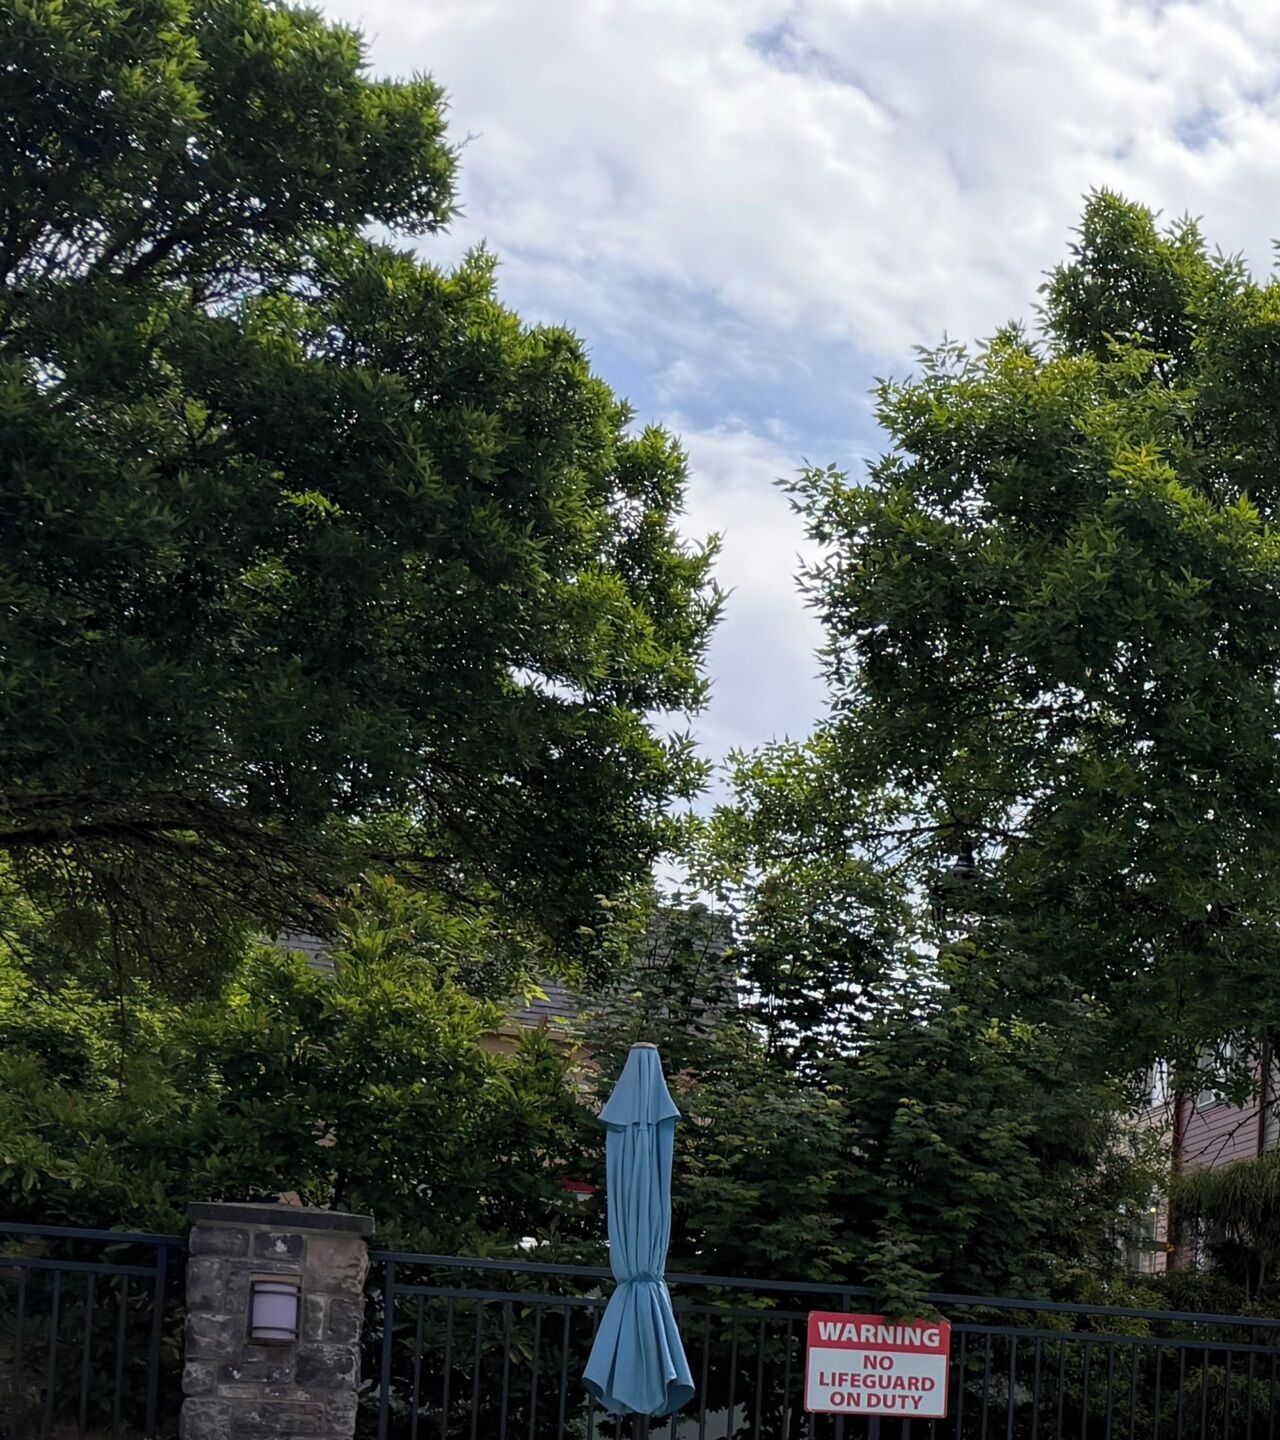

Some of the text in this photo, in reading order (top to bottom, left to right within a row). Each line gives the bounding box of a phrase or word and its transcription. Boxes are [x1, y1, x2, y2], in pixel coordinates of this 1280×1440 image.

[818, 1321, 940, 1347] WARNING
[863, 1355, 894, 1371] NO
[819, 1372, 935, 1391] LIFEGUARD
[830, 1391, 923, 1410] ON DUTY
